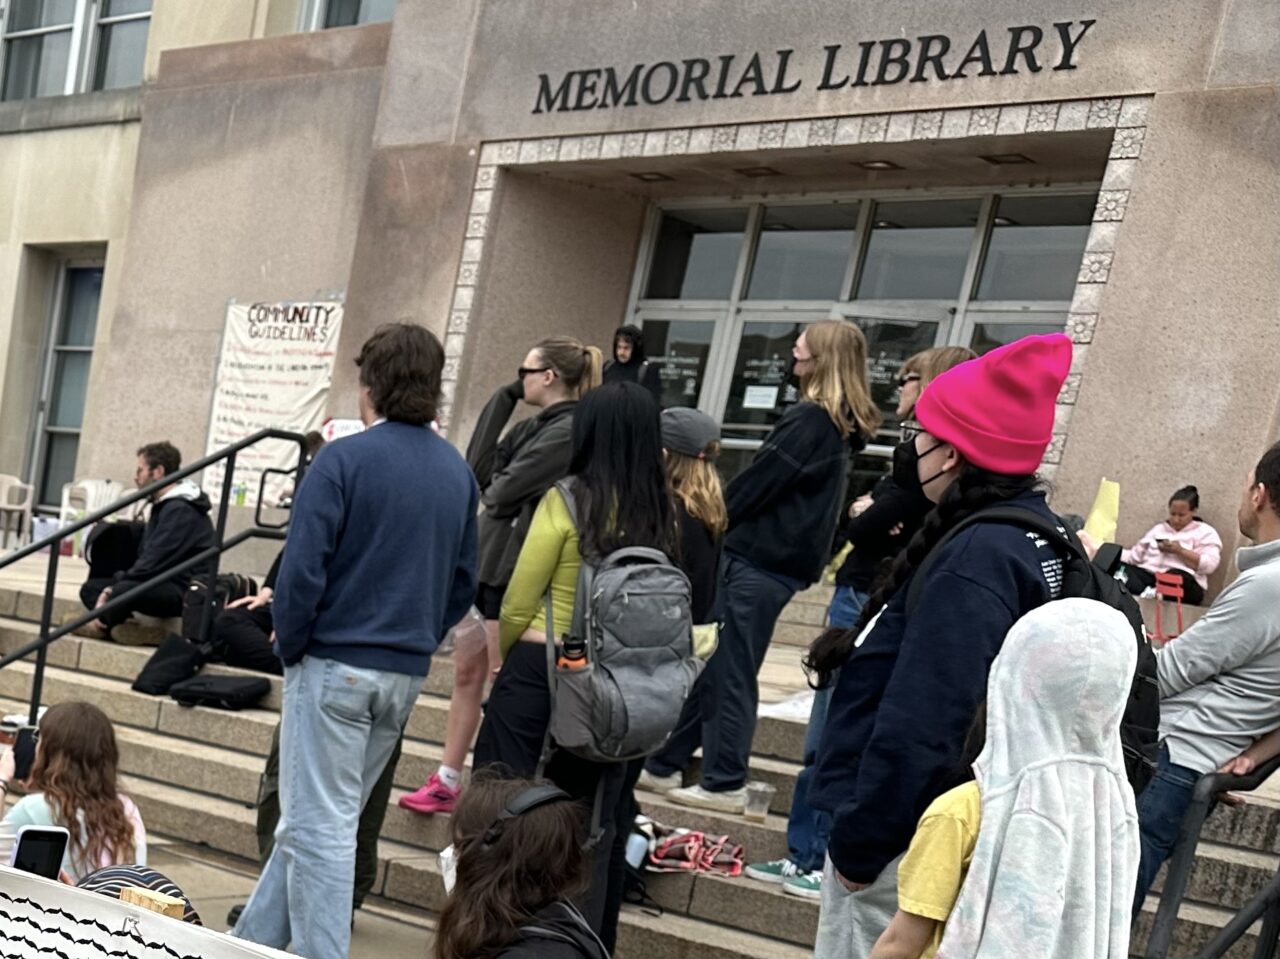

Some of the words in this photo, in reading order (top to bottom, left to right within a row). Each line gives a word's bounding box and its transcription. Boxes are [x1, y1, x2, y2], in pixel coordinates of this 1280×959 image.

[532, 50, 802, 115] MEMORIAL
[817, 19, 1097, 91] LIBRARY
[248, 303, 335, 325] COMMUNITY
[248, 324, 329, 343] GUIDELINES
